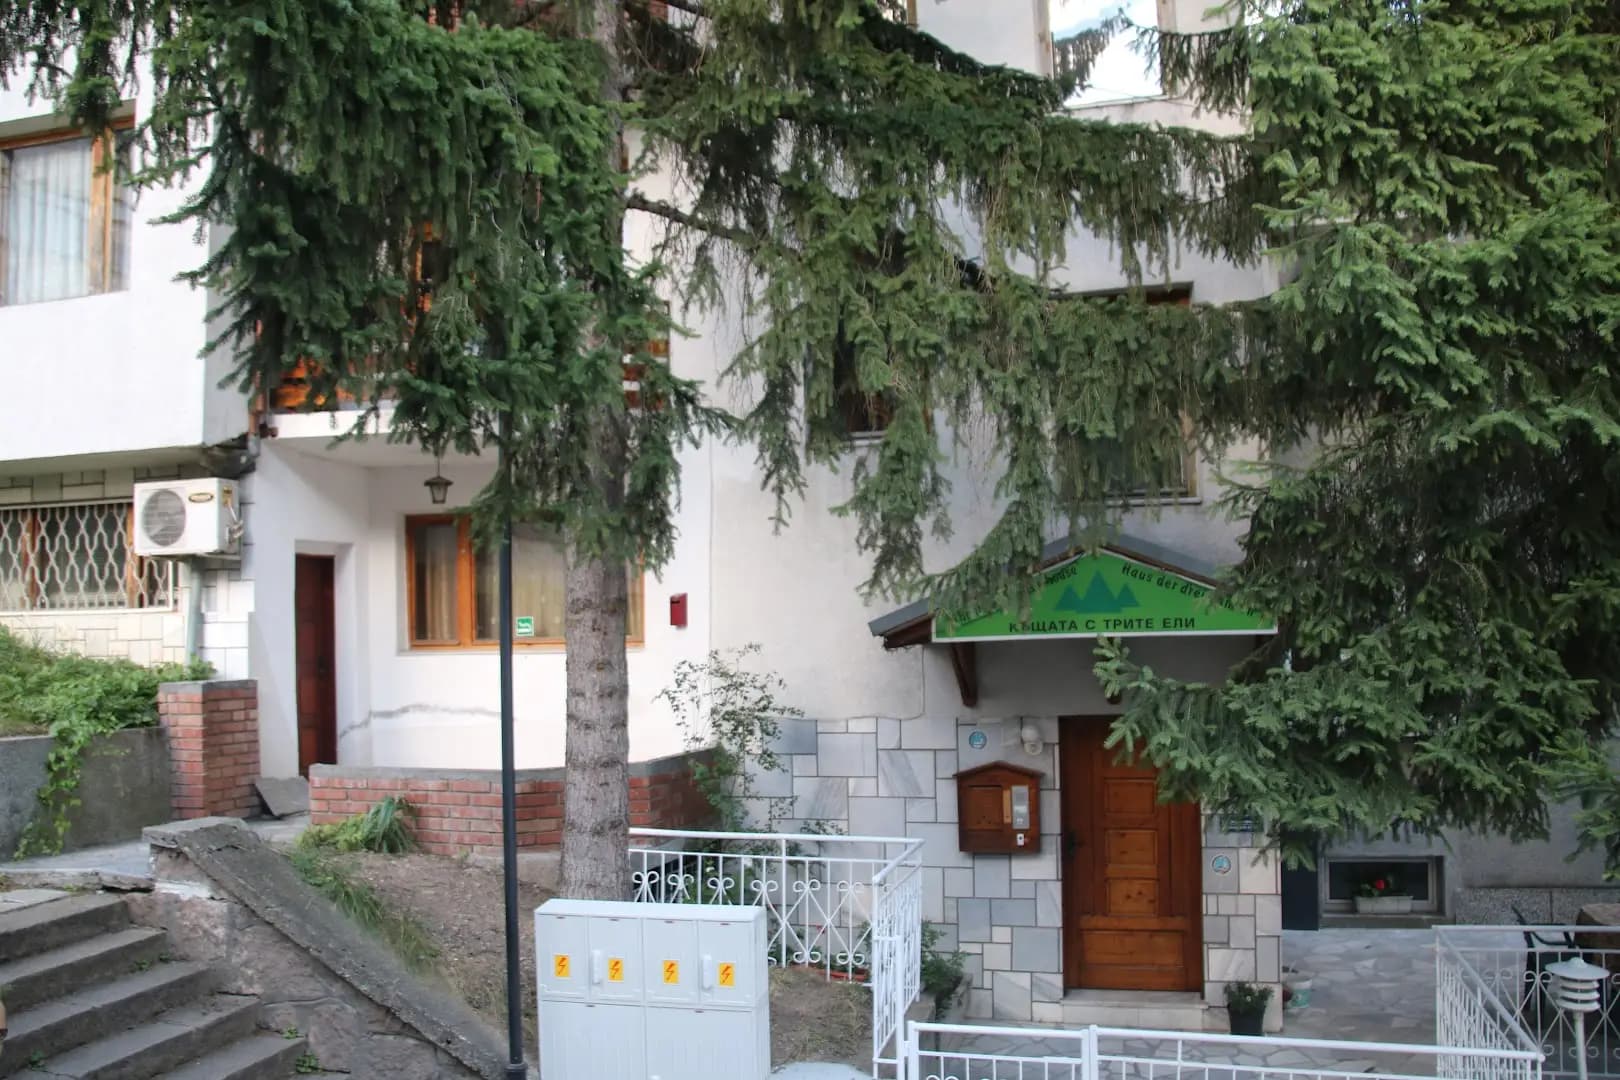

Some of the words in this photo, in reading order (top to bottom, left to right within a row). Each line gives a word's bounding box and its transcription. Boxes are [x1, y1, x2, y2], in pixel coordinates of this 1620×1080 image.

[1121, 563, 1152, 582] Haus
[1156, 576, 1178, 590] der
[1085, 619, 1096, 630] С
[1104, 618, 1153, 630] ТРИТЕ
[1162, 617, 1195, 628] ЕЛИ
